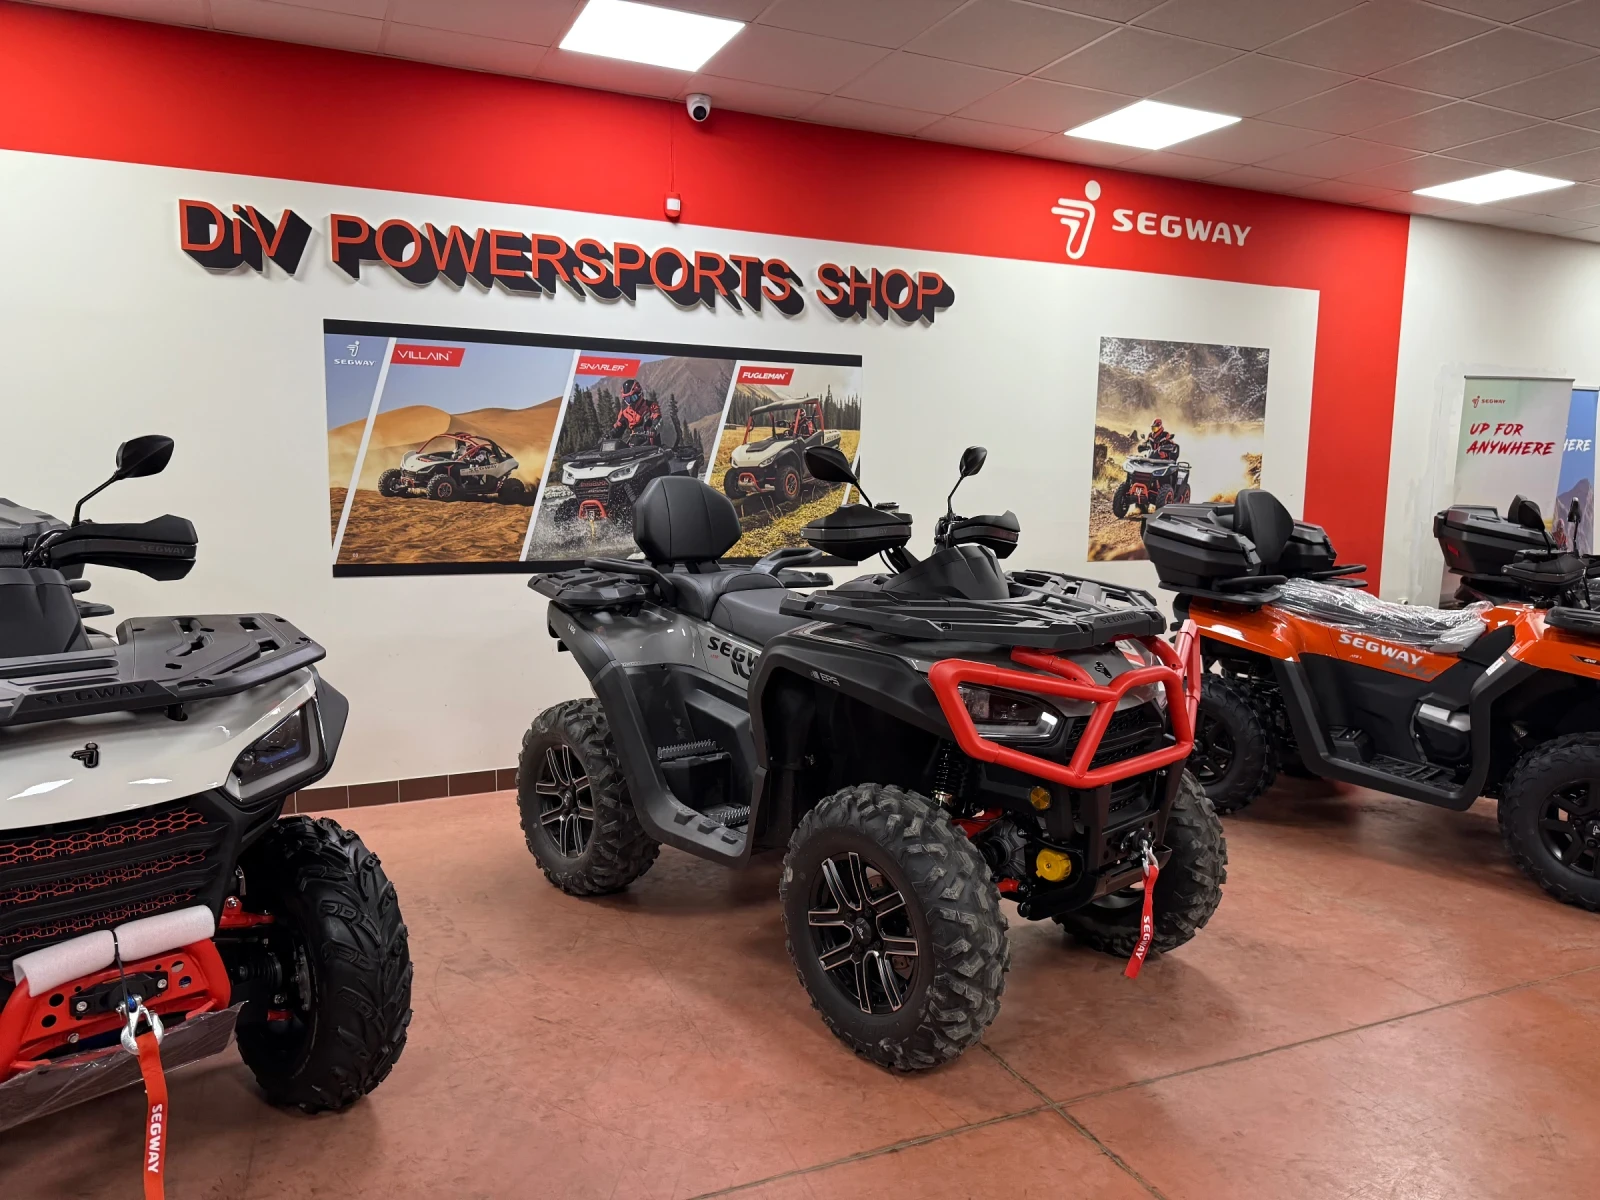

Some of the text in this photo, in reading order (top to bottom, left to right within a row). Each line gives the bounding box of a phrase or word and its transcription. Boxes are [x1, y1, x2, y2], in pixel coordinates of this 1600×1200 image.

[1112, 208, 1252, 247] SEGWAY
[178, 198, 950, 319] DiV POWERSPORTS SHOP
[333, 358, 376, 367] SEGWAY
[1469, 422, 1524, 437] UP FOR
[1465, 439, 1556, 456] ANYWHERE
[140, 543, 187, 555] SEGWAY
[1099, 611, 1138, 625] SEGWAY
[1338, 633, 1424, 666] SEGWAY
[34, 682, 148, 705] SEGWAY
[1135, 915, 1151, 960] SEGWAY
[147, 1103, 163, 1173] SEGWAY
